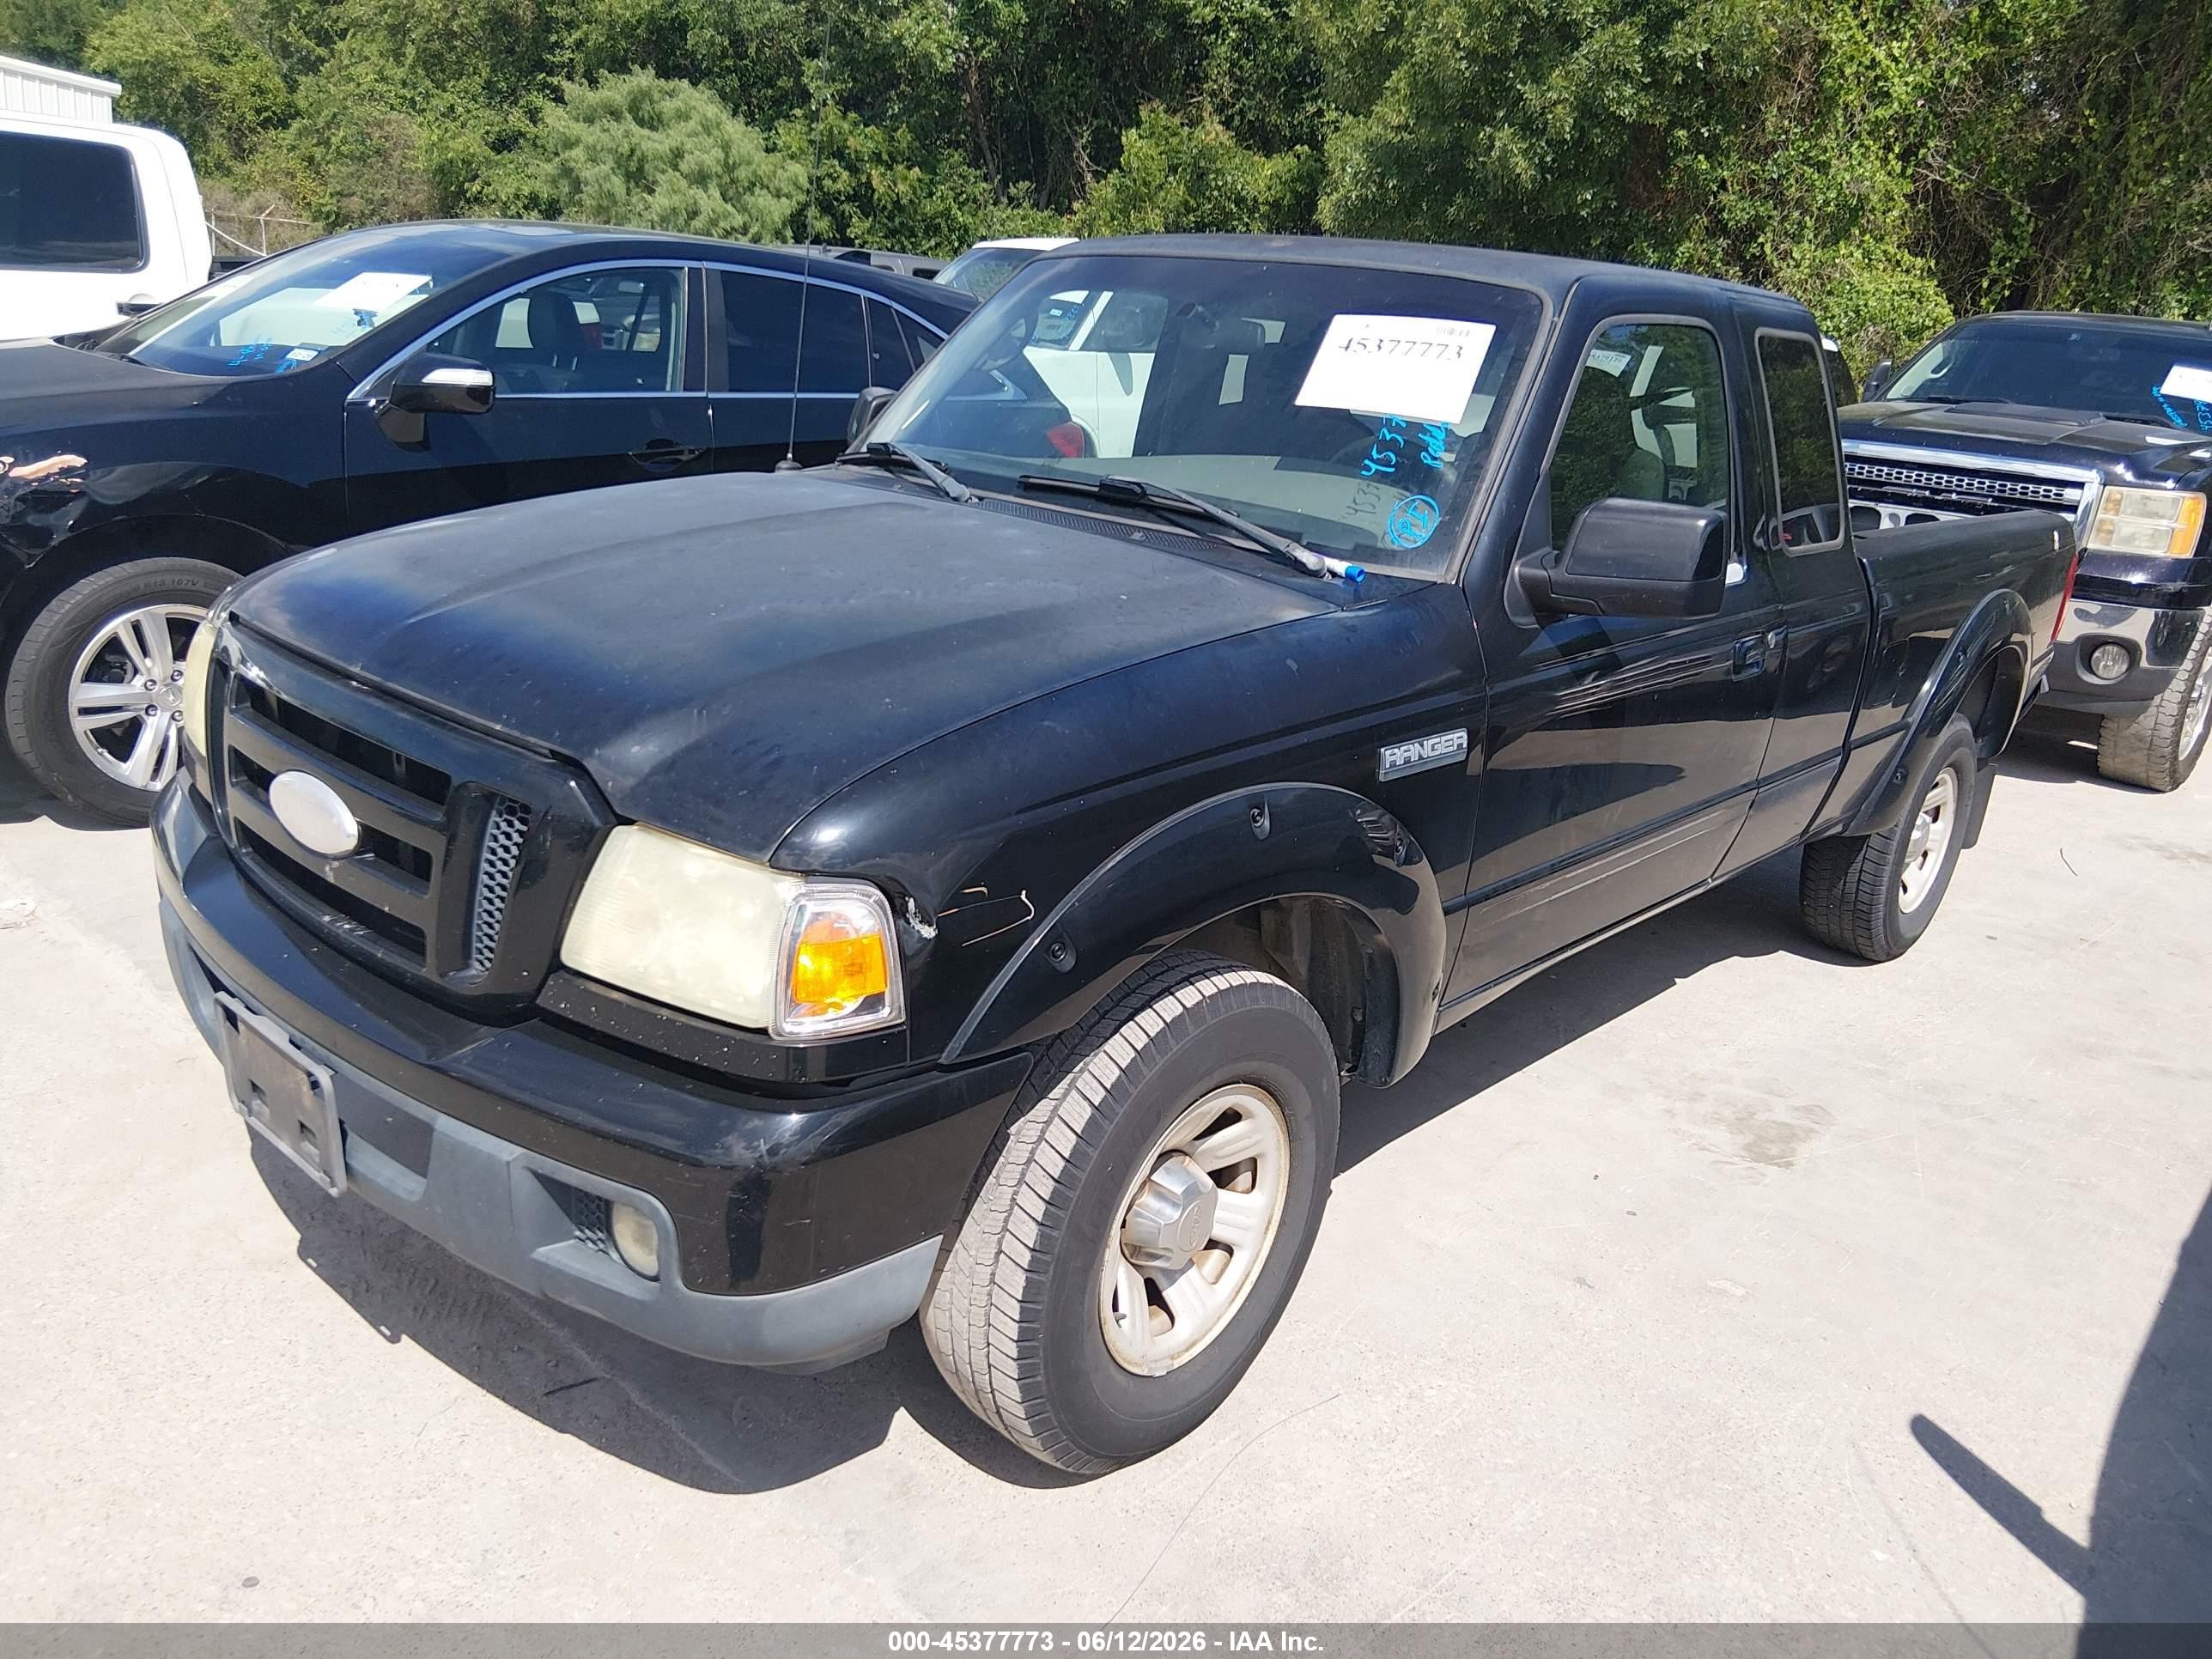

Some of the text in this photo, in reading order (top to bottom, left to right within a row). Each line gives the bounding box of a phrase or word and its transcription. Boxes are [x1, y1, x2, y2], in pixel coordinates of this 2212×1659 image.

[1338, 336, 1463, 361] 45377773
[170, 578, 200, 586] 107V
[1385, 732, 1468, 769] RANGER
